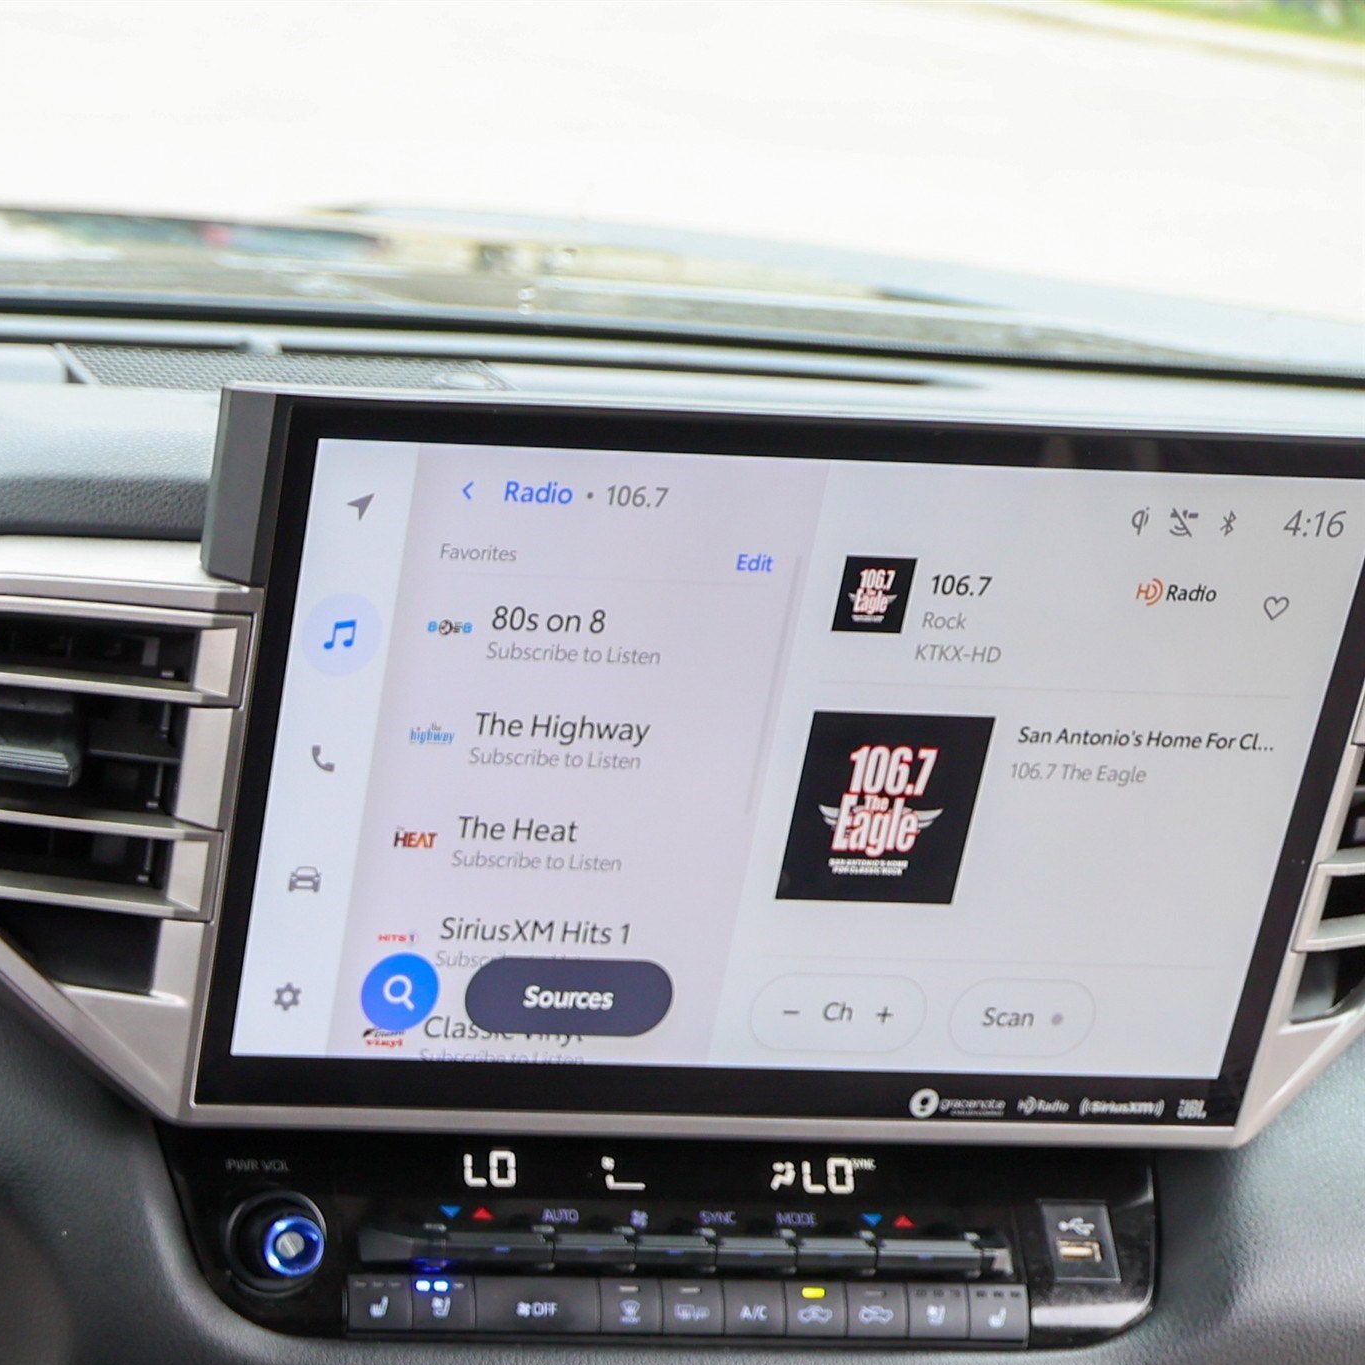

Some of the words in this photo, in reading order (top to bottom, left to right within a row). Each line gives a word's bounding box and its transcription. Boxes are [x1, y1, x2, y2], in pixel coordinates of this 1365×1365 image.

[504, 481, 573, 505] Radio
[605, 485, 669, 508] 106.7
[1283, 509, 1347, 538] 4:16
[439, 542, 518, 562] Favorites
[736, 553, 774, 572] Edit
[931, 574, 993, 597] 106.7
[1165, 583, 1218, 602] Radio
[492, 605, 538, 631] 80s
[547, 614, 581, 633] on
[589, 609, 606, 634] 8
[921, 611, 968, 631] Rock
[486, 641, 578, 662] Subscribe
[583, 645, 602, 663] to
[607, 647, 660, 665] Listen
[914, 644, 1002, 663] KTKX-HD
[476, 712, 524, 737] The
[531, 714, 650, 747] Highway
[1018, 727, 1052, 744] San
[1056, 728, 1143, 747] Antonio's
[1146, 731, 1202, 749] Home
[1205, 733, 1236, 750] For
[469, 746, 560, 767] Subscribe
[565, 751, 583, 768] to
[588, 752, 641, 769] Listen
[847, 745, 940, 796] 106.7
[1010, 763, 1056, 779] 106.7
[1061, 764, 1092, 781] The
[1096, 766, 1147, 787] Eagle
[863, 794, 890, 811] The
[459, 815, 505, 840] The
[512, 818, 578, 843] Heat
[830, 792, 921, 857] Eagle
[394, 830, 437, 848] HEAT
[452, 850, 542, 869] Subscribe
[546, 853, 564, 870] to
[569, 854, 622, 871] Listen
[440, 917, 555, 943] SiriusXM
[561, 922, 613, 944] Hits
[619, 924, 631, 944] 1
[523, 985, 614, 1010] Sources
[823, 1002, 853, 1022] Ch
[983, 1007, 1035, 1027] Scan
[226, 1159, 259, 1171] PWR
[464, 1150, 516, 1187] LO
[802, 1157, 855, 1194] LO
[542, 1209, 579, 1223] AUTO
[699, 1211, 736, 1225] SYNC
[776, 1212, 817, 1227] MODE
[532, 1302, 558, 1318] OFF
[740, 1305, 768, 1321] A/C
